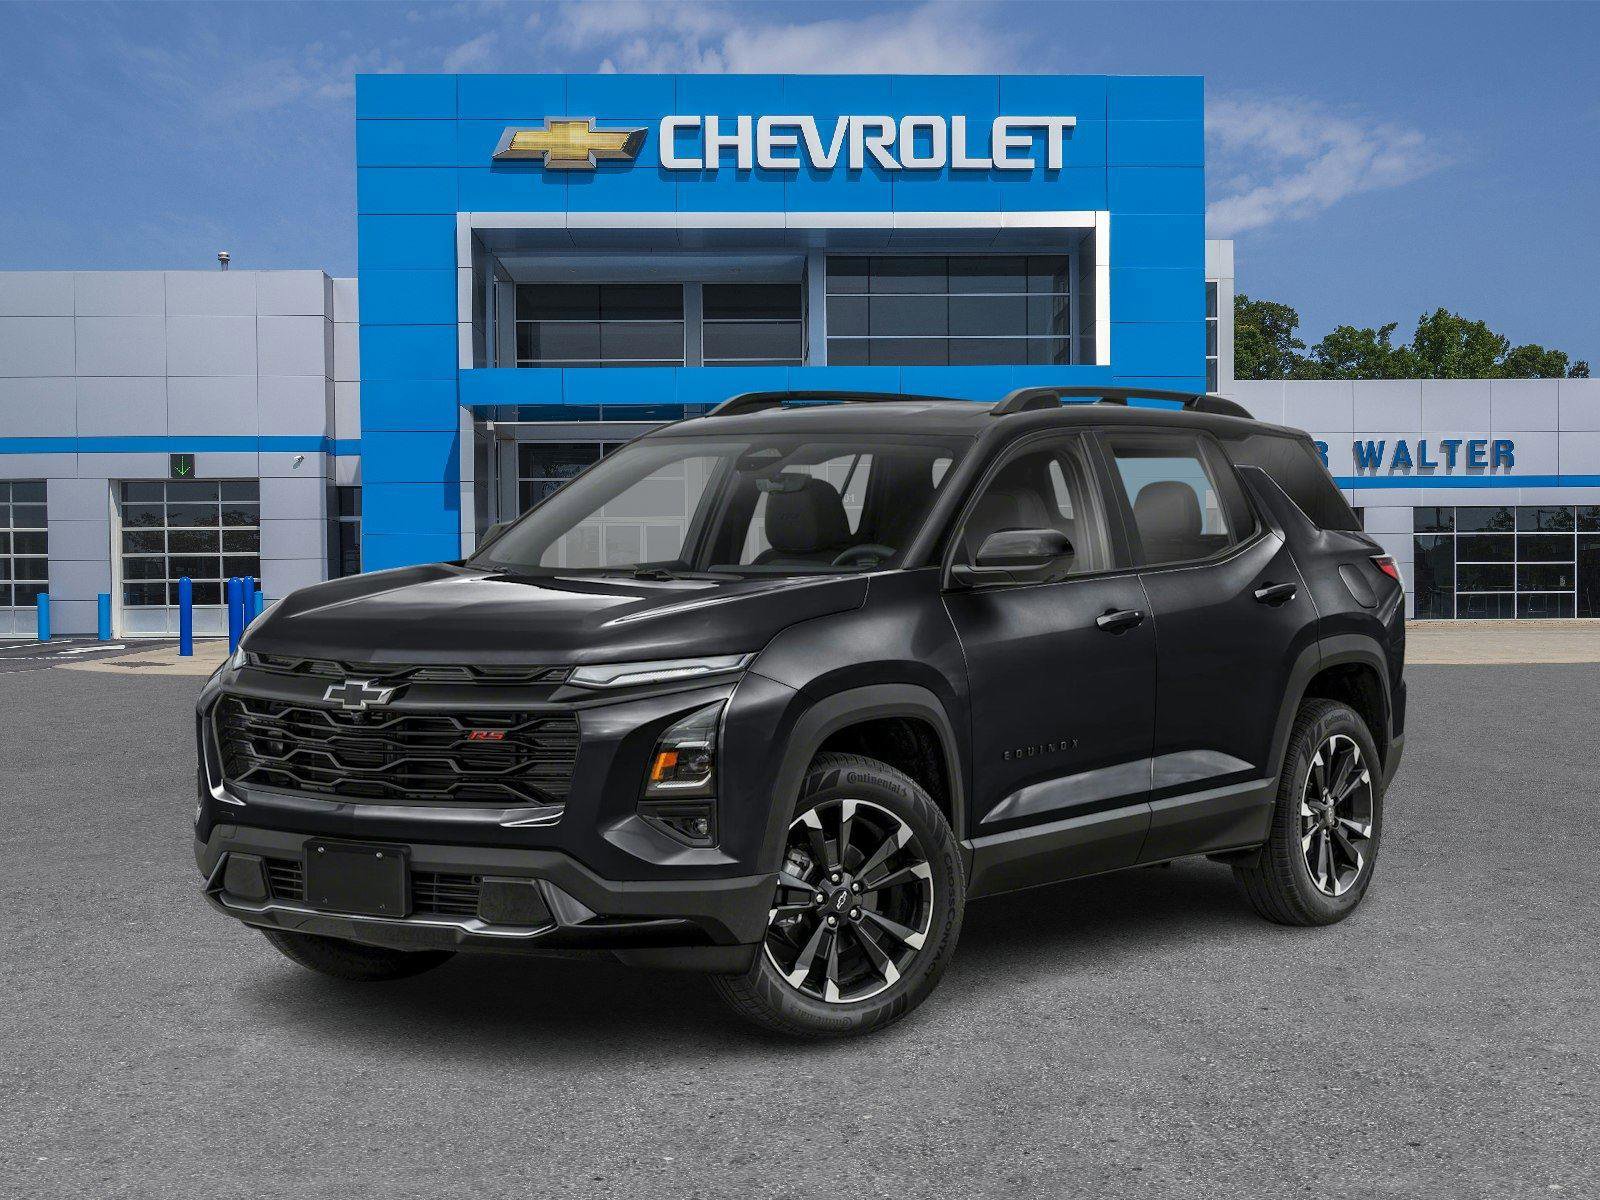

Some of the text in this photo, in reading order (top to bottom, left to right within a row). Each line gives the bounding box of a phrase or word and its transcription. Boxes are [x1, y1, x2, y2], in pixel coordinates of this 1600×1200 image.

[660, 115, 1077, 169] CHEVROLET
[1353, 440, 1515, 469] WALTER
[468, 729, 506, 740] RS
[1004, 739, 1079, 760] EQUINOX
[847, 771, 902, 795] Continental
